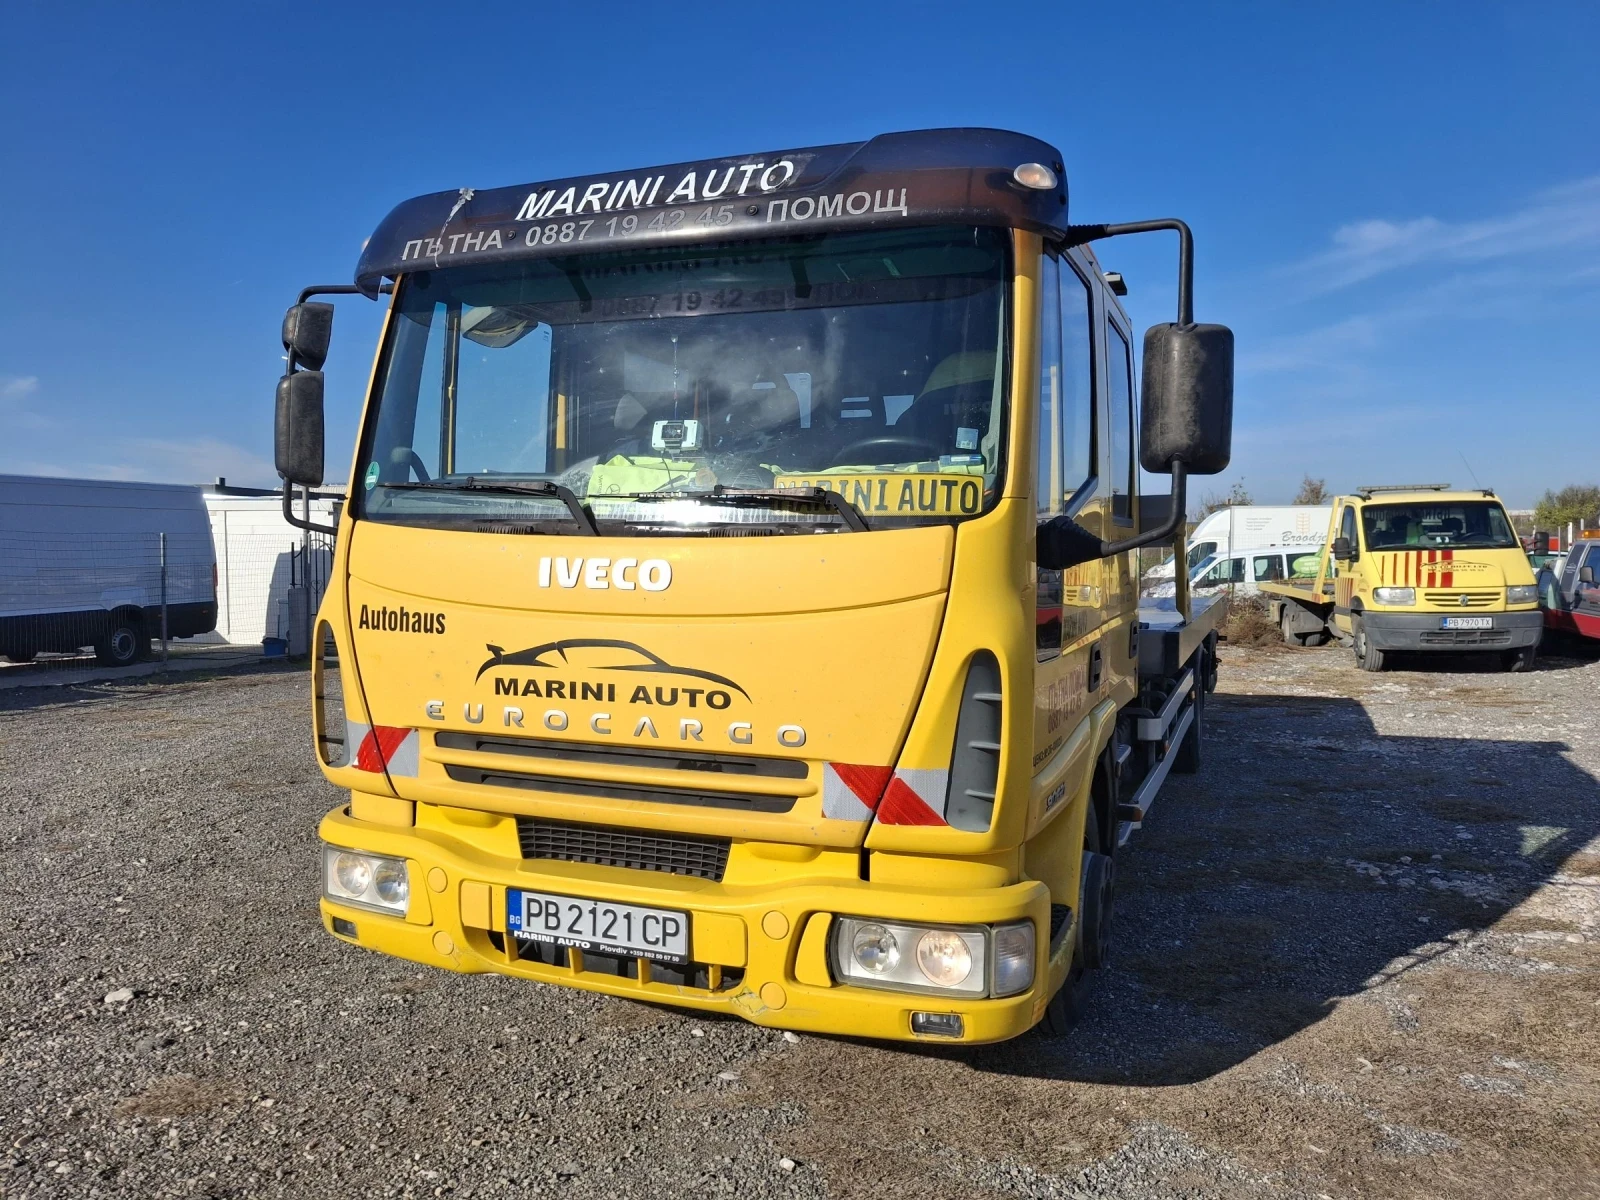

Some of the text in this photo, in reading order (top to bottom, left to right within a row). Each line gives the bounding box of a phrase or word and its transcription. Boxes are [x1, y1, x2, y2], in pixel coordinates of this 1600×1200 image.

[515, 161, 794, 221] MARINI AUTO
[401, 188, 908, 261] ПЪТНА 0887 19 42 45 ПОМОЩ
[898, 479, 979, 514] AUTO
[538, 557, 673, 591] IVECO
[359, 604, 446, 635] Autohaus
[494, 676, 732, 711] MARINI AUTO
[425, 700, 807, 748] EUROCARGO
[509, 914, 521, 925] BG
[513, 930, 554, 944] MARINI
[557, 936, 591, 949] AUTO
[600, 944, 628, 955] Plovdiv
